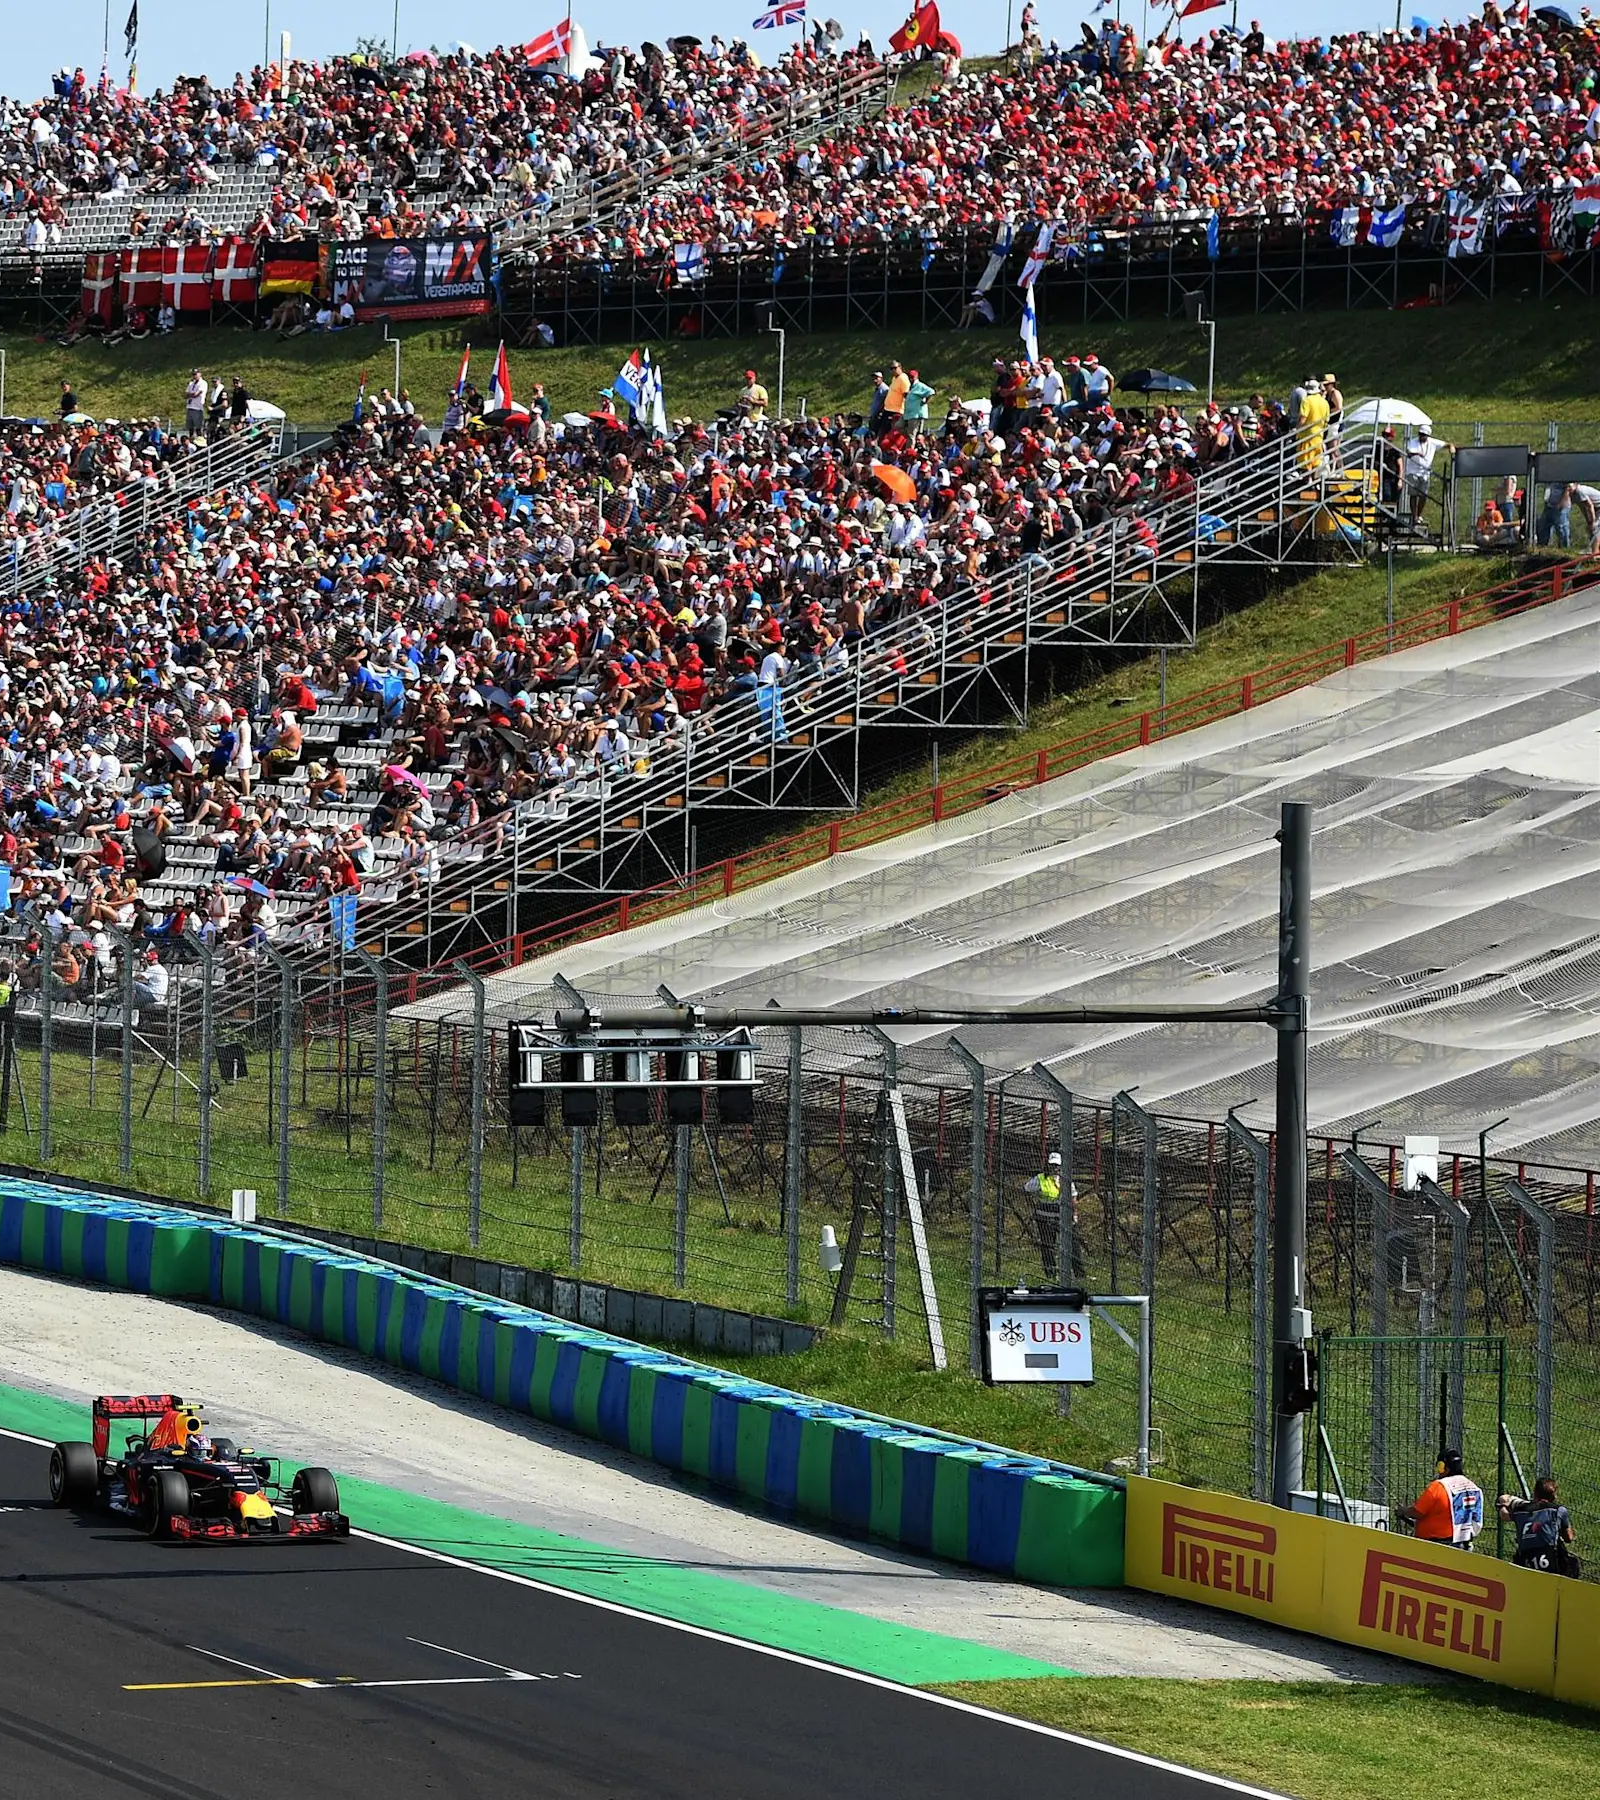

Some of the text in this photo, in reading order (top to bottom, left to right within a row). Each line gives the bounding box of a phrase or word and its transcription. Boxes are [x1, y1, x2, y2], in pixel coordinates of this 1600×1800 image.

[335, 247, 367, 265] RACE
[337, 266, 364, 276] TO THE
[1029, 1321, 1082, 1343] UBS
[1162, 1503, 1277, 1602] PIRELLI
[1358, 1549, 1506, 1663] PIRELLI
